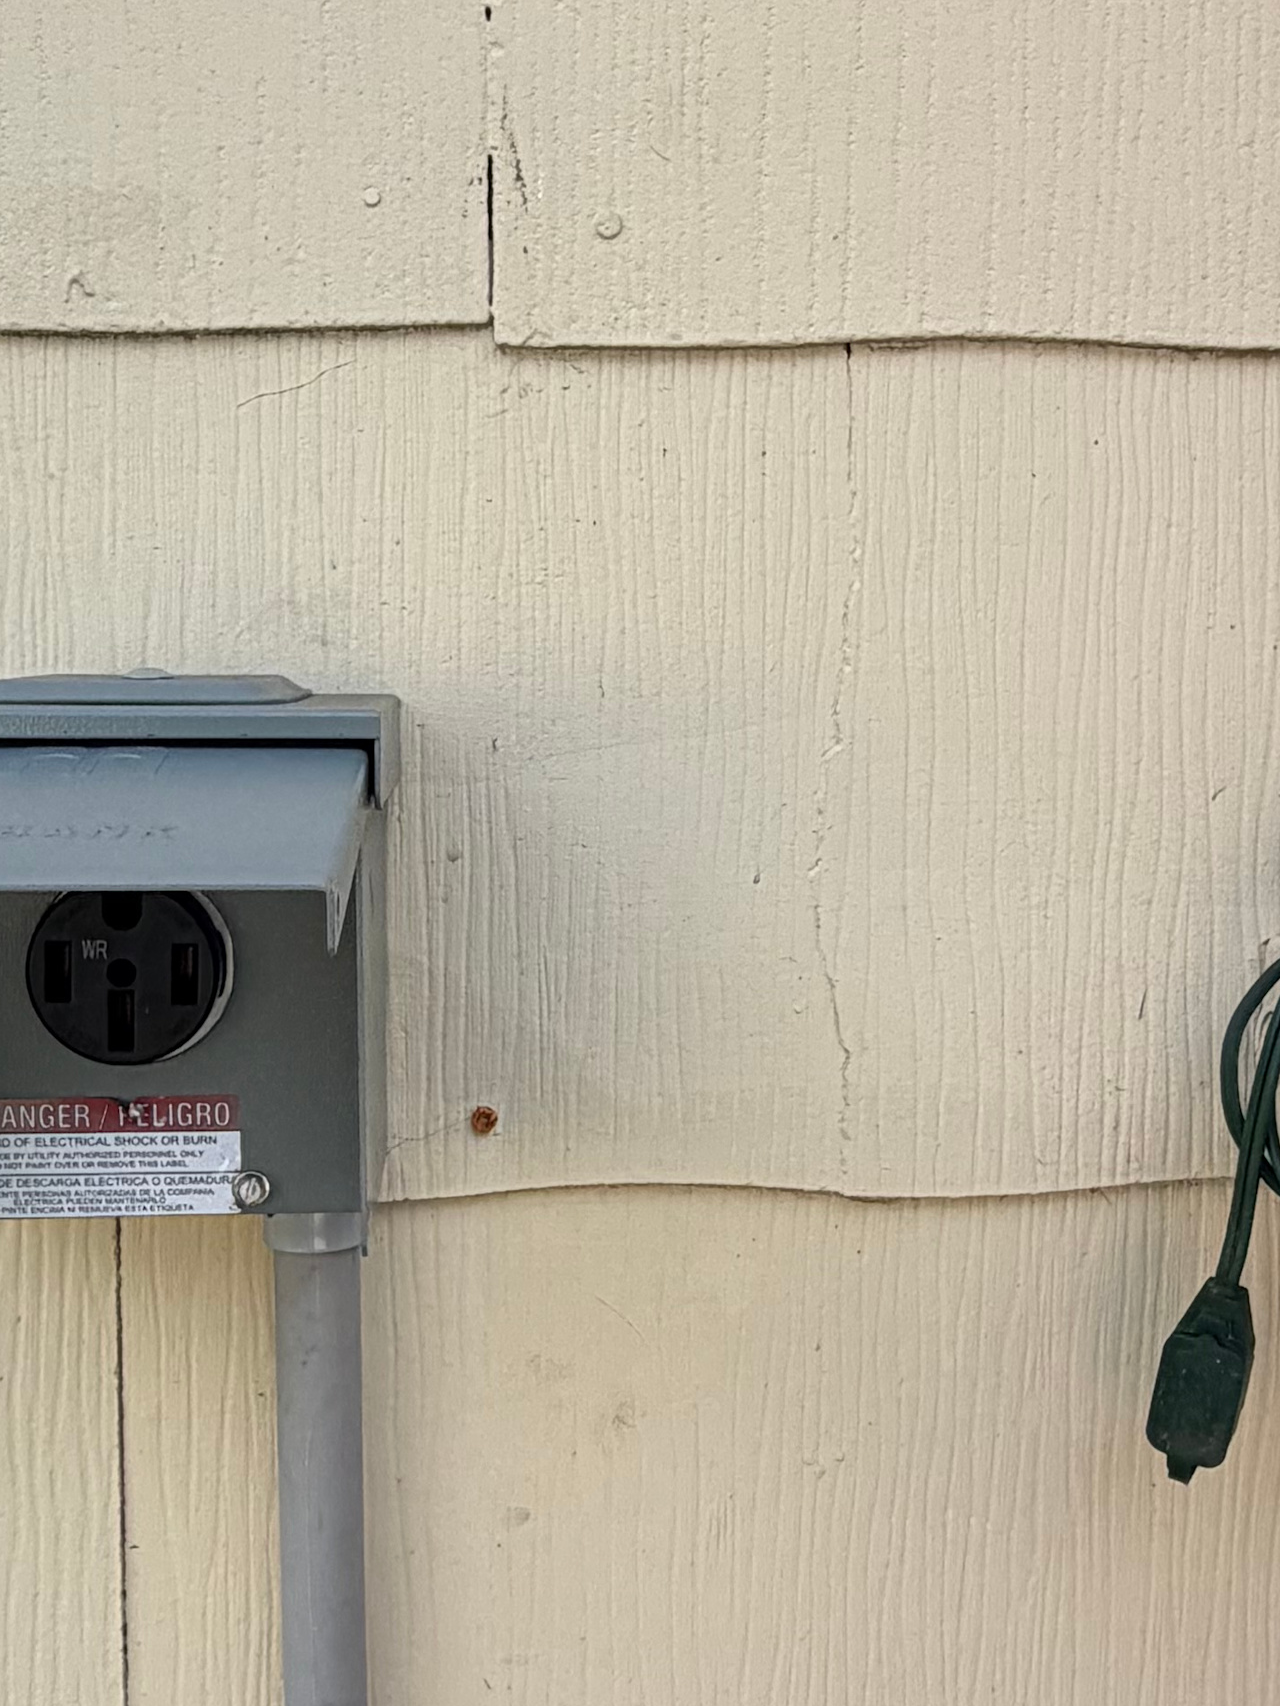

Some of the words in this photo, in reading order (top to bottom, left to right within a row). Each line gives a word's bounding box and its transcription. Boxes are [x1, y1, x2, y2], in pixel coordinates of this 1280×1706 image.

[81, 939, 108, 961] WR
[14, 1137, 33, 1148] OF
[35, 1136, 111, 1148] ELECTRICAL
[114, 1135, 159, 1146] SHOCK
[161, 1135, 179, 1146] OR
[183, 1135, 218, 1146] BURN
[27, 1152, 61, 1160] UTILITY
[180, 1149, 205, 1158] ONLY
[4, 1162, 23, 1170] NOT
[54, 1161, 79, 1169] OVER
[16, 1177, 82, 1188] DESCARGA
[152, 1176, 161, 1186] O
